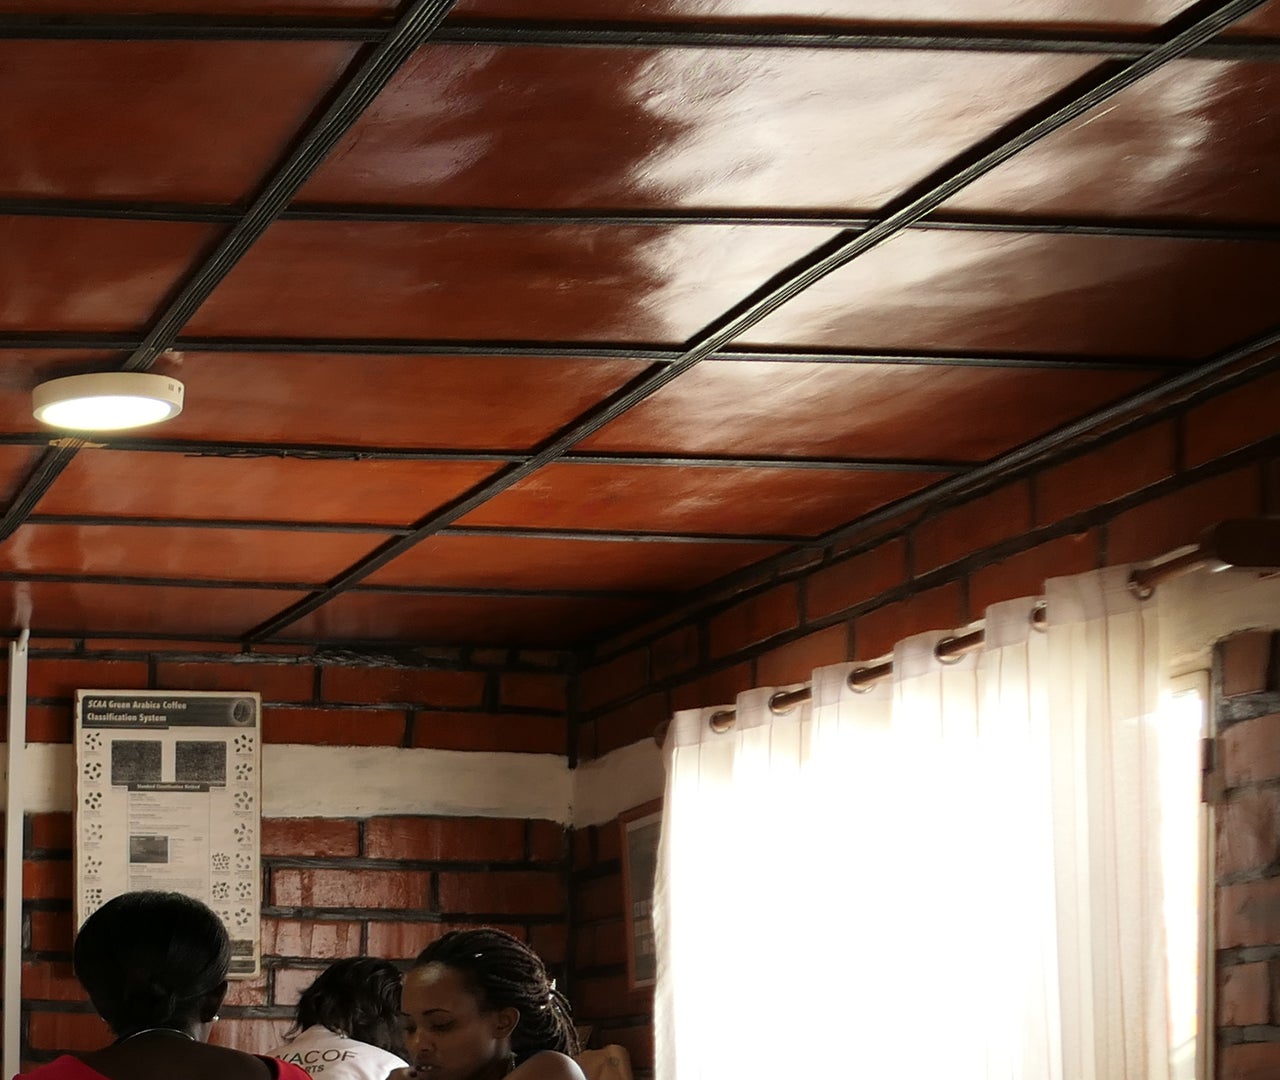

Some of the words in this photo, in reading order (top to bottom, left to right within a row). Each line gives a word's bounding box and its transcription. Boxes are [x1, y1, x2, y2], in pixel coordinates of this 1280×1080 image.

[87, 700, 107, 708] SCAA
[108, 700, 131, 709] Green
[133, 701, 161, 709] Arabica
[162, 701, 187, 710] Coffee
[87, 713, 138, 721] Classification
[139, 714, 167, 723] System
